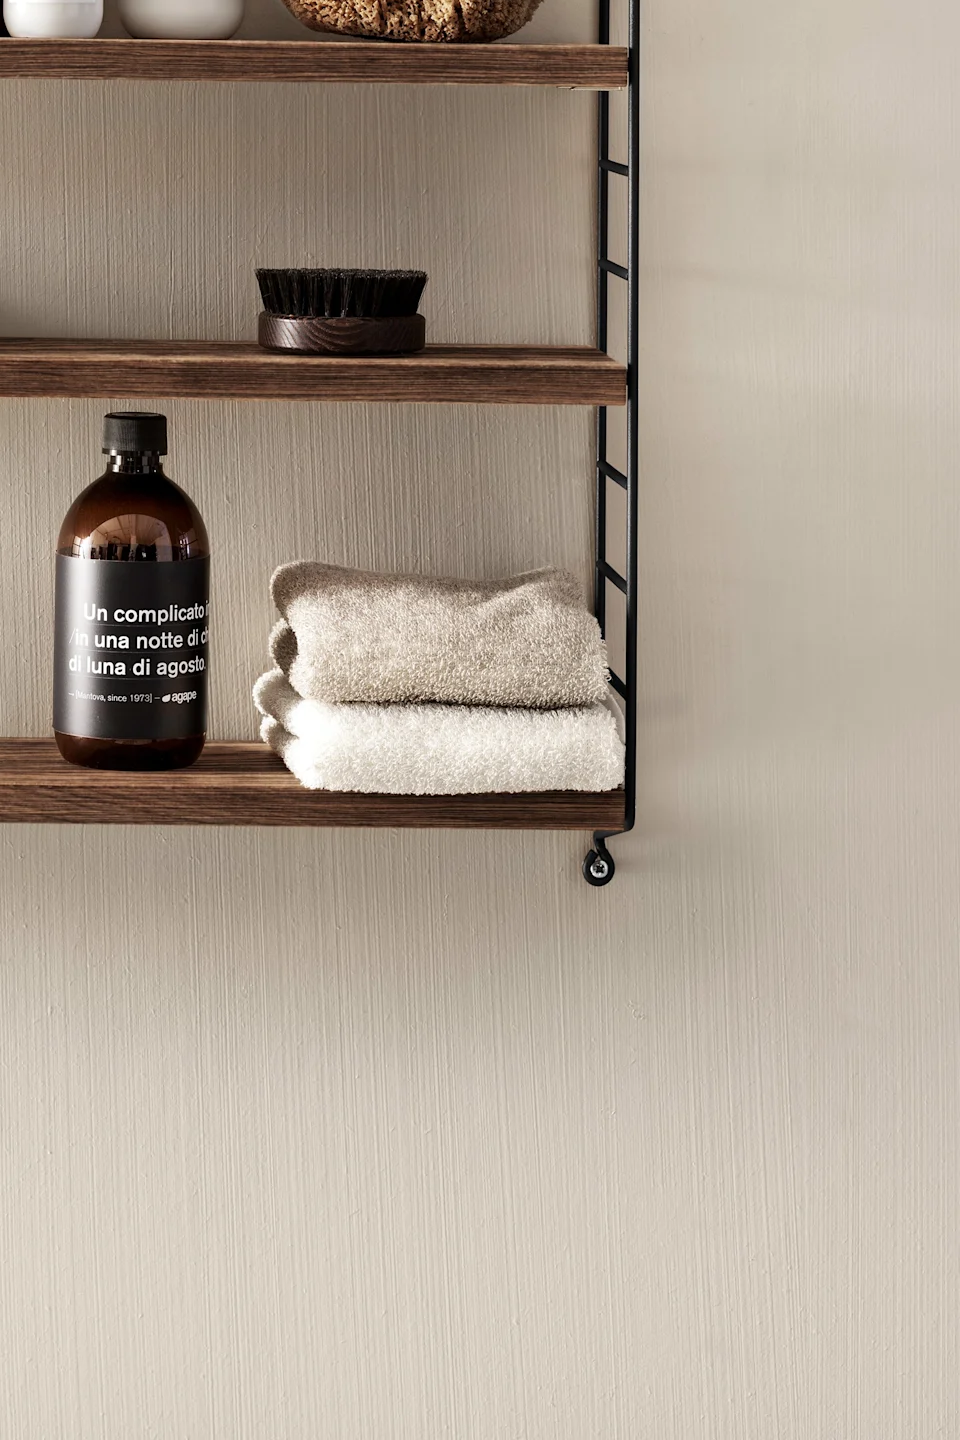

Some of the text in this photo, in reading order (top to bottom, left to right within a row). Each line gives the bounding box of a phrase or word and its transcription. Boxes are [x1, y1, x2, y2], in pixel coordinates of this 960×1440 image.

[83, 602, 108, 622] Un
[114, 604, 205, 626] complicato
[94, 634, 130, 649] una
[136, 632, 183, 649] notte
[187, 629, 199, 647] di
[69, 655, 206, 678] di luna di agosto.
[107, 694, 127, 702] since
[130, 694, 153, 703] 1973]
[171, 690, 197, 704] agape
